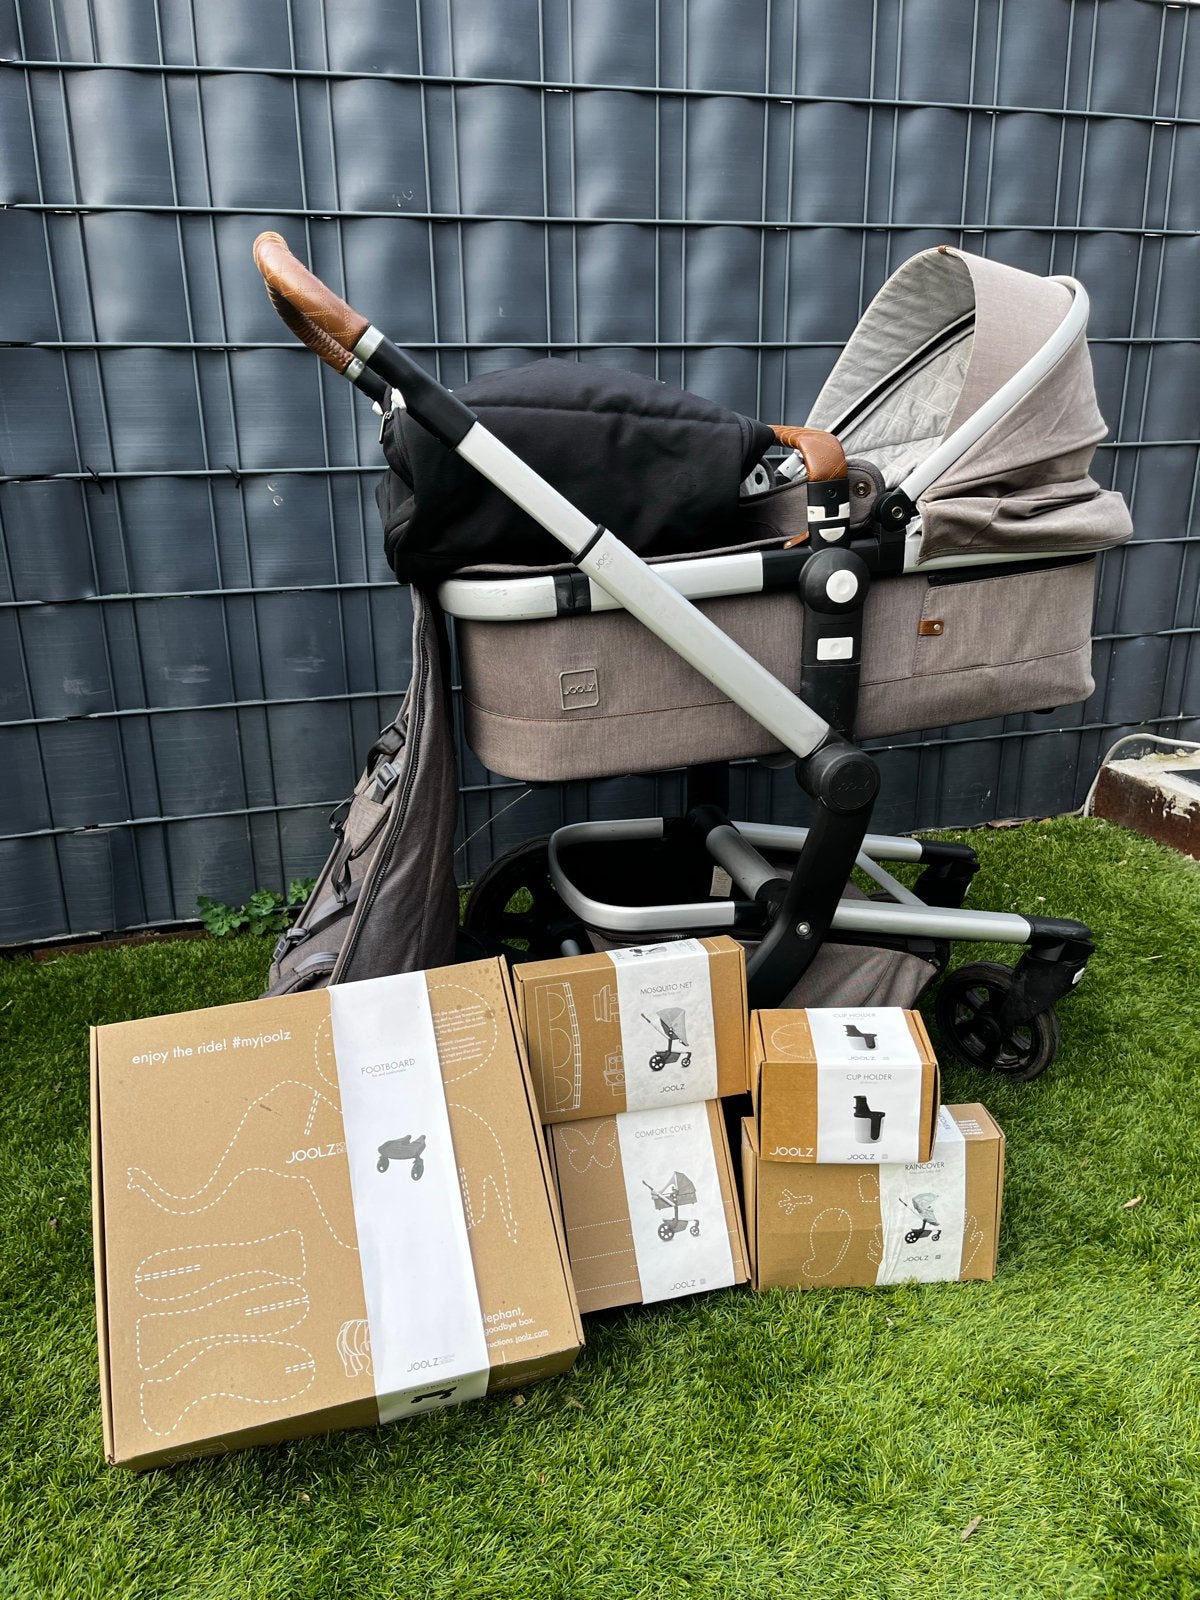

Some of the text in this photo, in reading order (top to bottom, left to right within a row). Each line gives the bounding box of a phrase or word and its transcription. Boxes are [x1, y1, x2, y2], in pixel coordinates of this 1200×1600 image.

[562, 682, 596, 696] JOOLZ
[640, 983, 679, 995] MOSQUITO
[679, 981, 693, 990] NET
[132, 1029, 292, 1066] enjoy the ride! #myjoolz
[360, 1057, 416, 1075] FOOTBOARD
[846, 1073, 893, 1081] CUP HOLDER
[659, 1083, 686, 1094] JOOLZ
[634, 1127, 668, 1139] COMFORT
[669, 1123, 693, 1134] COVER
[285, 1143, 337, 1164] JOOLZ
[769, 1146, 814, 1158] JOOLZ
[846, 1153, 876, 1161] JOOLZ
[904, 1161, 945, 1171] RAINCOVER
[670, 1279, 696, 1291] JOOLZ
[483, 1306, 525, 1325] lephant,
[484, 1321, 517, 1337] goodbye
[406, 1357, 440, 1373] JOOLZ
